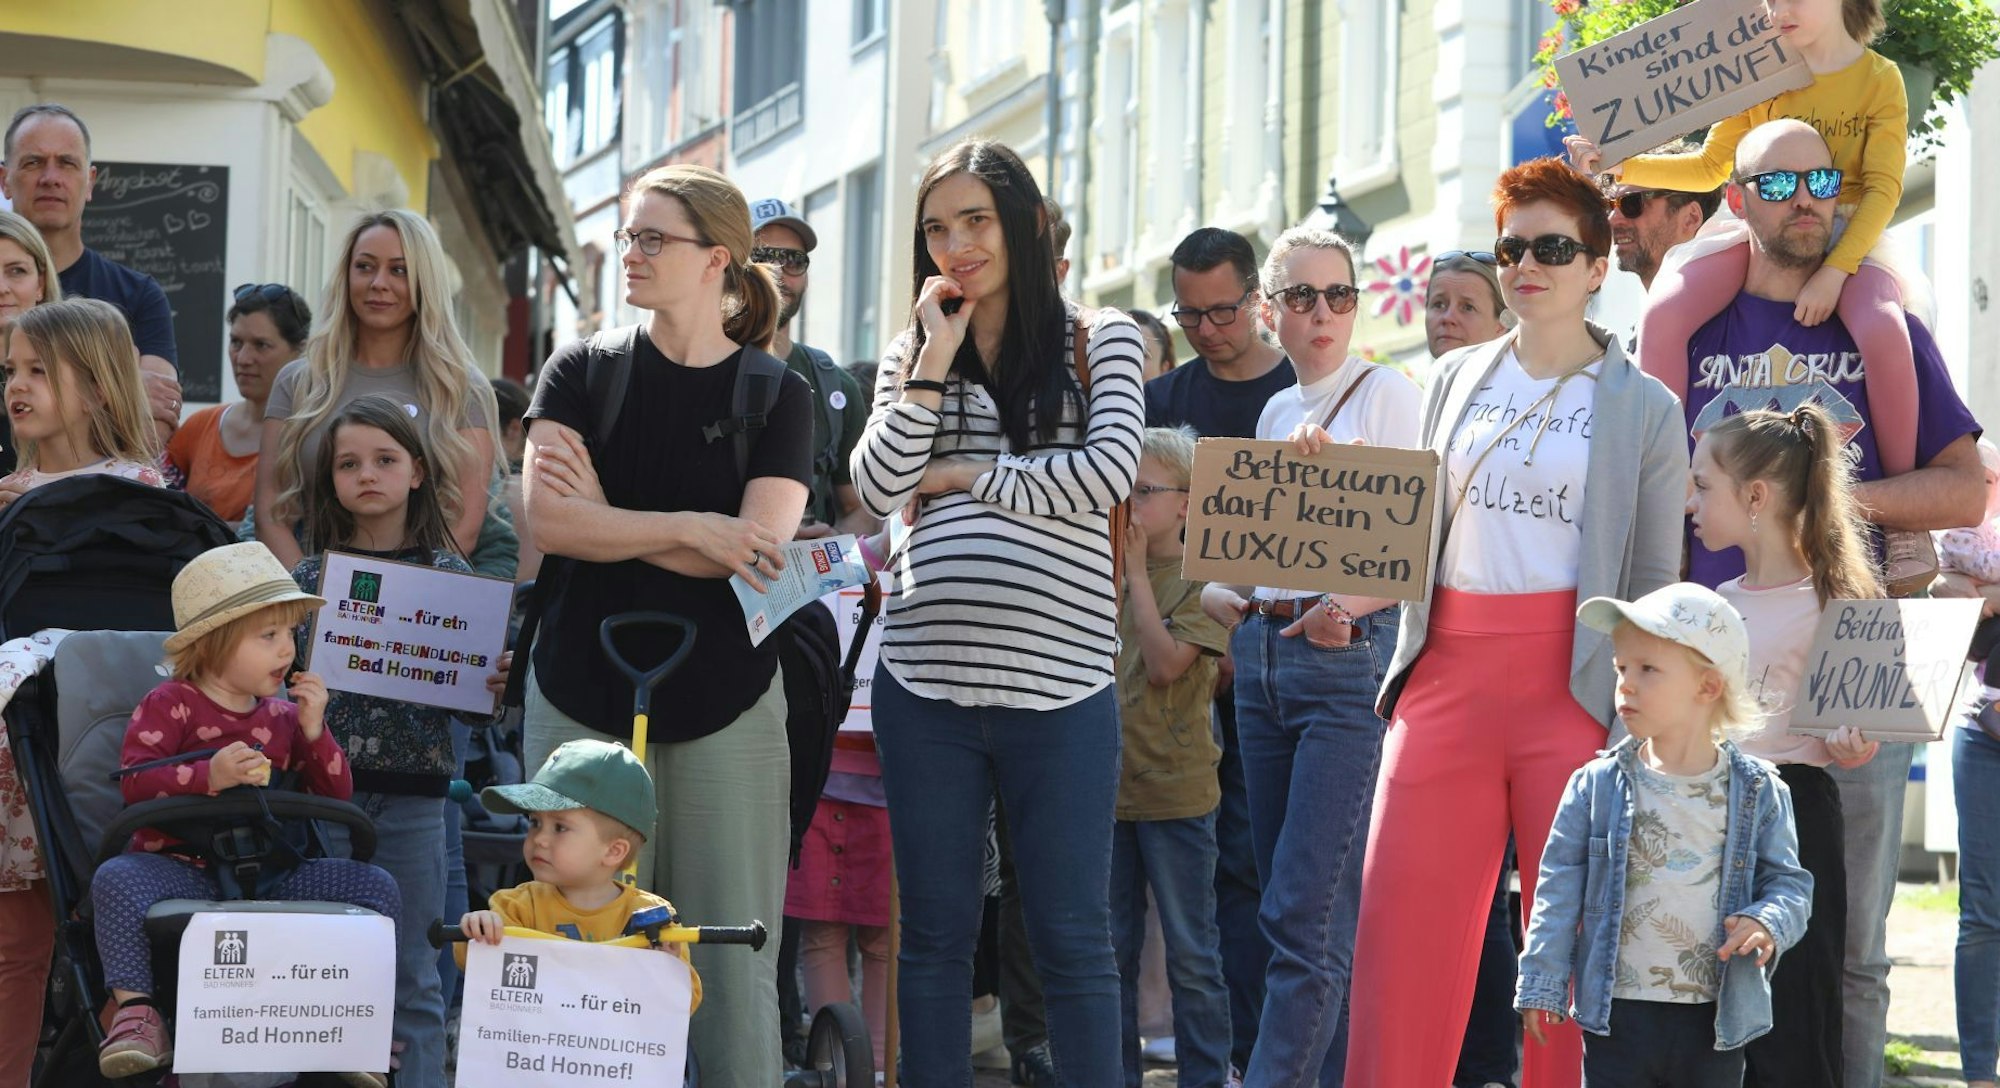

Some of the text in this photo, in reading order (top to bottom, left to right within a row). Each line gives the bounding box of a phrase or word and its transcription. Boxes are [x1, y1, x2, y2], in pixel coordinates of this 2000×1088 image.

[1578, 20, 1692, 79] Kinder
[1646, 12, 1774, 79] sind die
[1592, 35, 1788, 145] ZUKUNFT
[97, 166, 182, 199] Angebot
[1694, 352, 1865, 389] SANTA CRUZ
[1226, 449, 1426, 526] Betreuung
[1202, 485, 1371, 531] darf kein
[814, 550, 829, 572] GENUG
[1200, 528, 1411, 582] LUXUS sein
[338, 600, 385, 617] ELTERN
[415, 609, 440, 626] für
[442, 615, 468, 631] ein
[325, 631, 488, 668] familien-FREUNDLICHES
[348, 654, 458, 686] Bad Honnef!
[204, 968, 255, 979] ELTERN
[291, 964, 320, 980] für
[321, 965, 349, 980] ein
[193, 1005, 375, 1019] familien-FREUNDLICHES
[490, 989, 543, 1004] ELTERN
[581, 994, 608, 1011] für
[612, 998, 641, 1015] ein
[222, 1026, 343, 1044] Bad Honnef!
[477, 1026, 666, 1057] familien-FREUNDLICHES
[506, 1052, 633, 1080] Bad Honnef!
